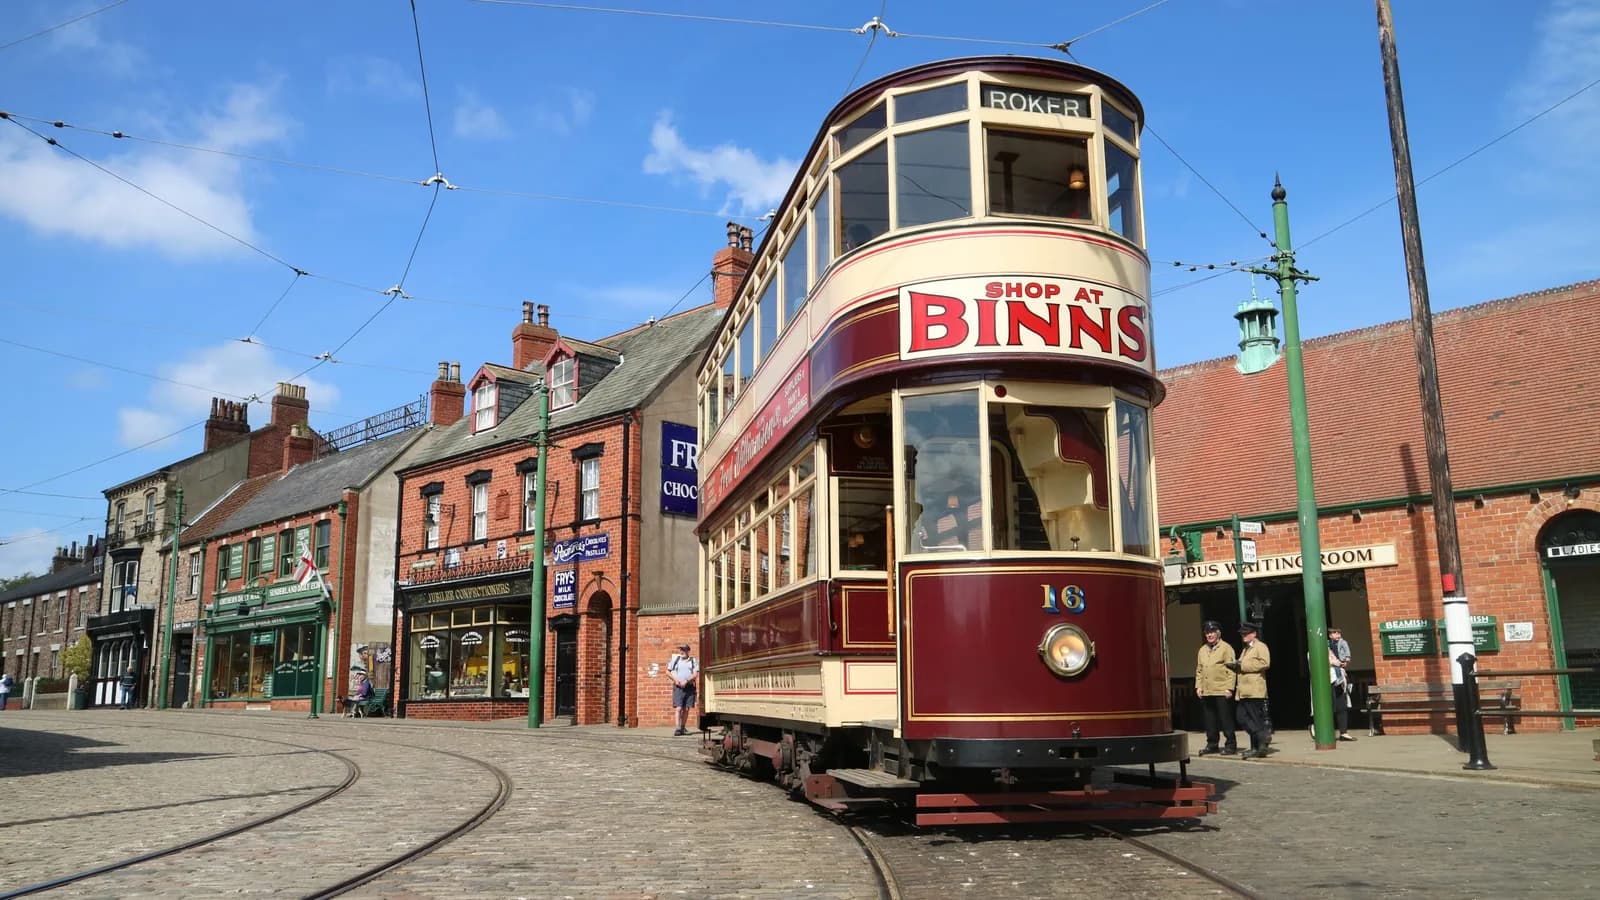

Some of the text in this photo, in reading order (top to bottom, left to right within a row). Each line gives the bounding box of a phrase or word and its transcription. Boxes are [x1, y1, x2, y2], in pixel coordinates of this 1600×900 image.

[990, 90, 1080, 117] ROKER
[985, 281, 1104, 305] SHOP AT
[1187, 565, 1219, 579] BUS
[1320, 549, 1373, 566] ROOM
[455, 583, 511, 601] CONFECTIONERS
[1040, 584, 1086, 614] 16
[1385, 620, 1428, 629] BEAMISH
